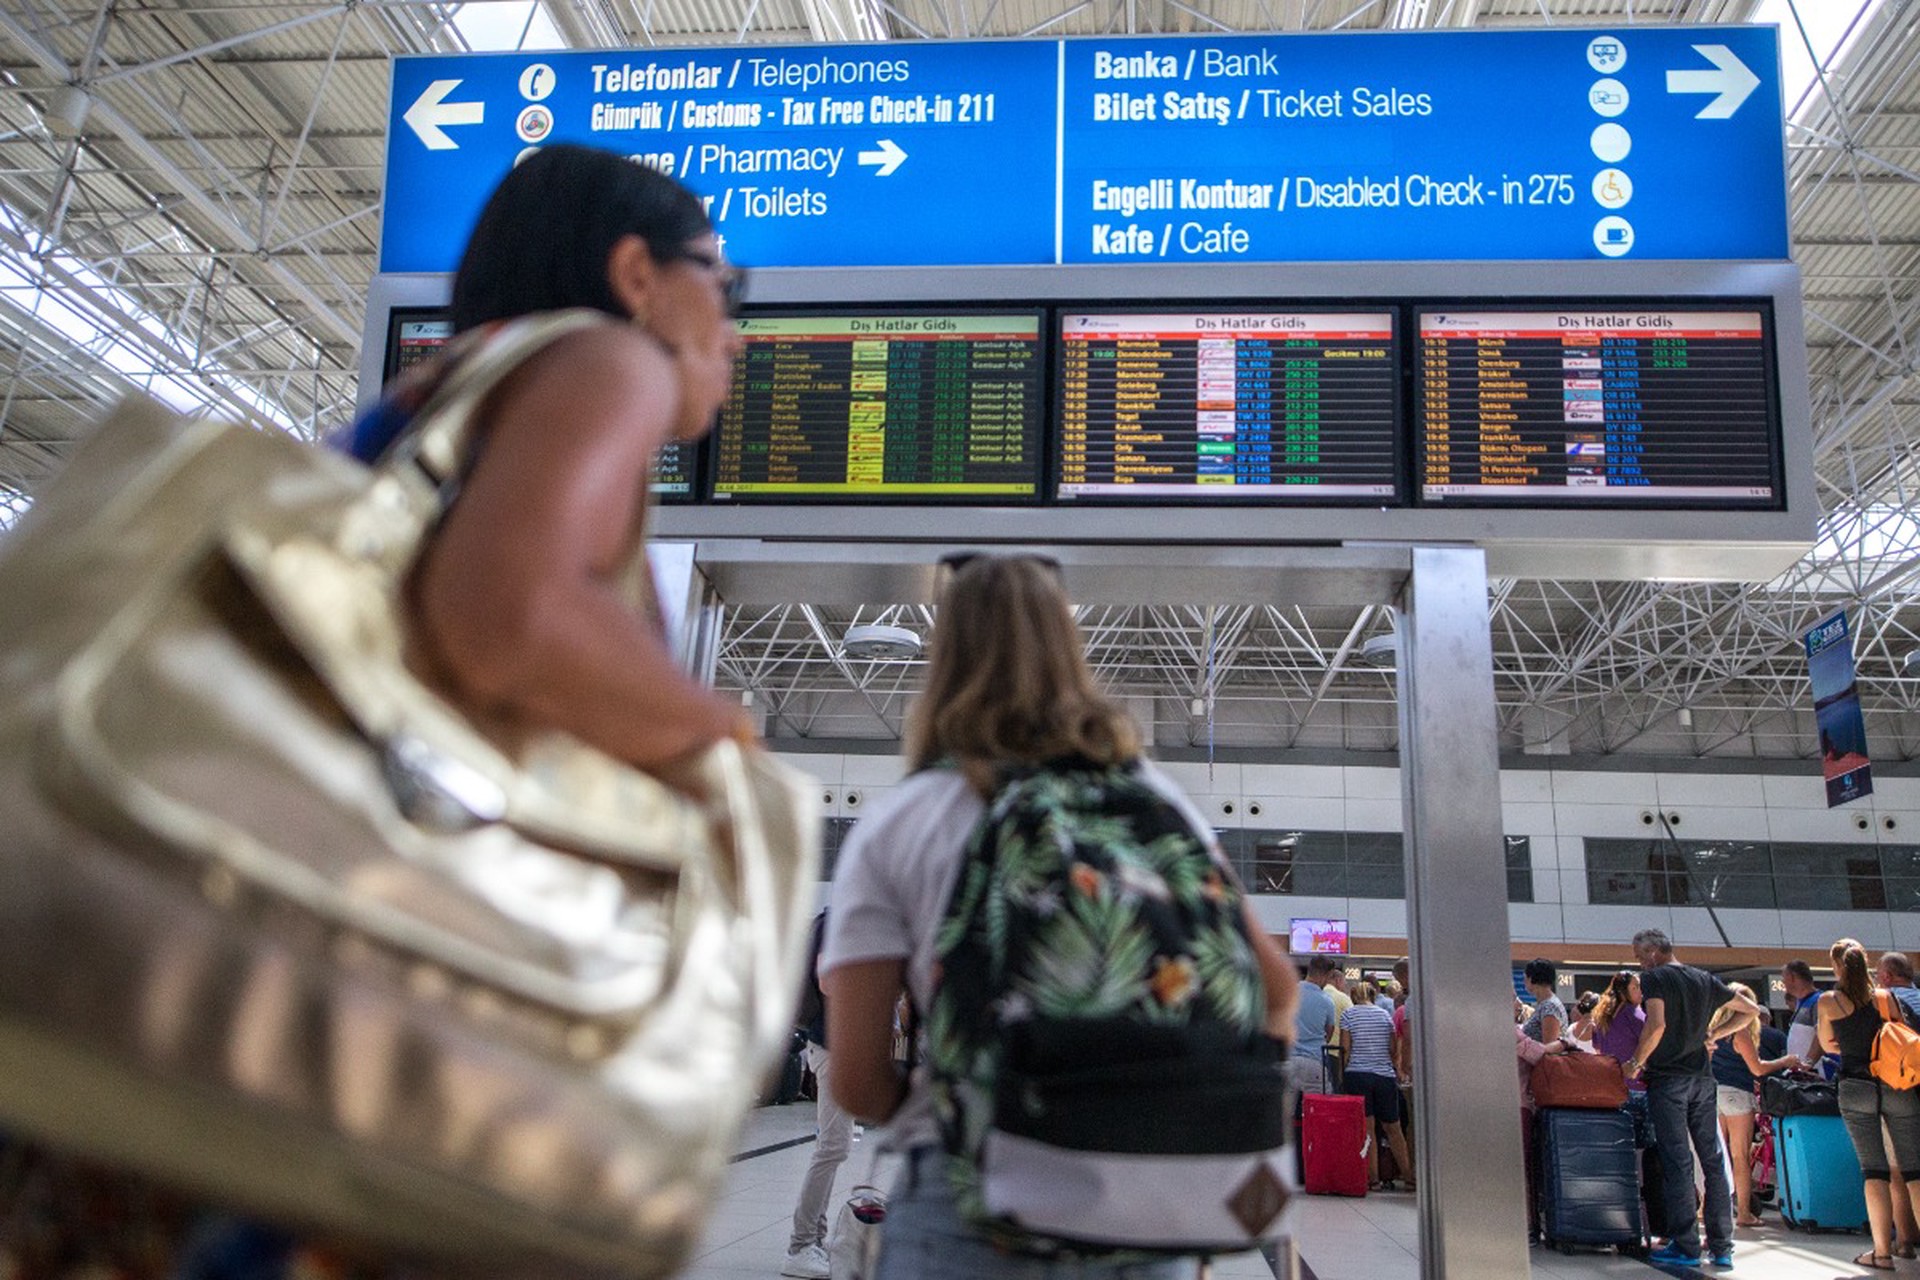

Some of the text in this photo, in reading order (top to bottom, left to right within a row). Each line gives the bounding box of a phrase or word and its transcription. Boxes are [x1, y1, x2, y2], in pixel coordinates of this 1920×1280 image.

[592, 57, 909, 92] Telefonlar / Telephones
[1095, 49, 1277, 80] Banka / Bank
[592, 102, 662, 131] Gümrük
[667, 101, 677, 131] /
[683, 100, 761, 128] Customs
[782, 98, 814, 125] Tax
[821, 97, 864, 124] Free
[870, 95, 952, 123] Check-in
[959, 94, 994, 122] 211
[1094, 88, 1431, 125] Bilet Satış / Ticket Sales
[701, 145, 843, 177] Pharmacy
[739, 187, 827, 217] Toilets
[1093, 179, 1173, 216] Engelli
[1180, 179, 1273, 209] Kontuar
[1278, 178, 1289, 211] /
[1529, 175, 1574, 204] 275
[1093, 222, 1249, 256] Kafe / Cafe
[876, 320, 918, 330] Hatlar
[1222, 318, 1265, 328] Hatlar
[1558, 316, 1673, 328] Dış Hatlar Gidiş
[1558, 974, 1572, 986] 241
